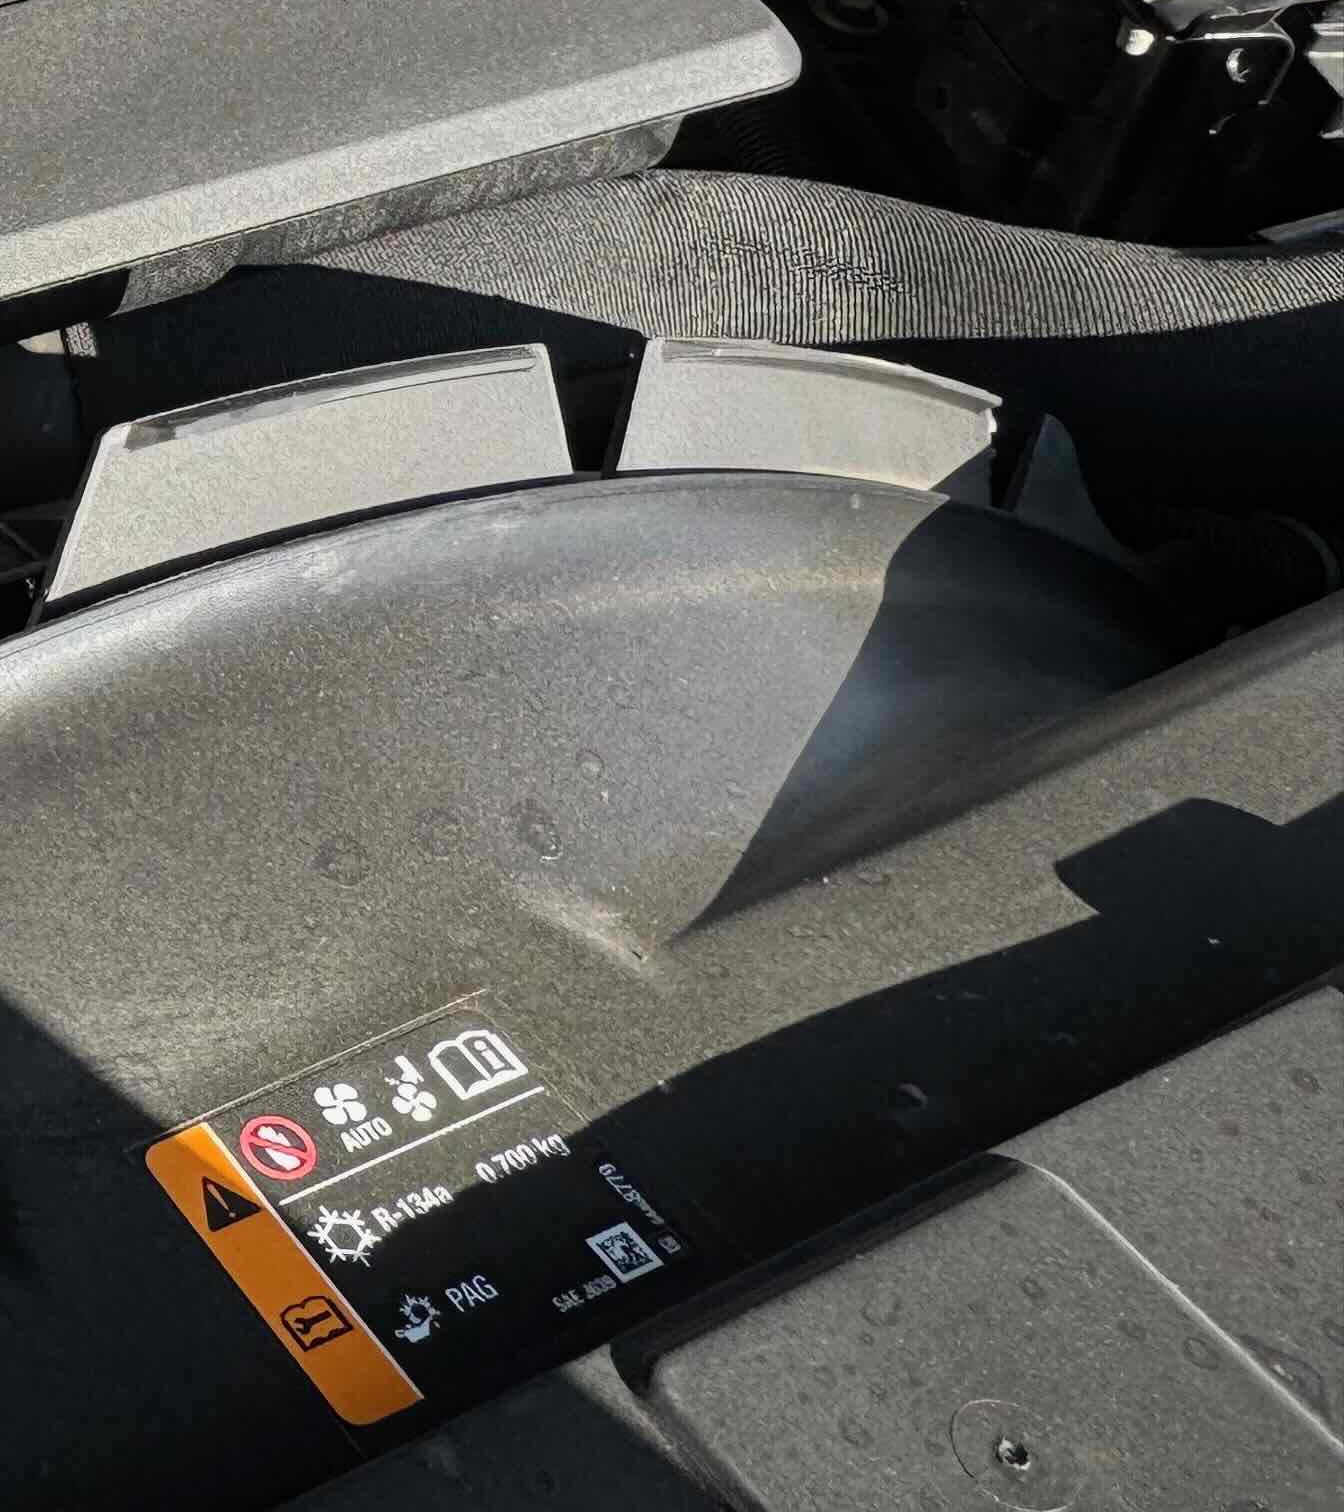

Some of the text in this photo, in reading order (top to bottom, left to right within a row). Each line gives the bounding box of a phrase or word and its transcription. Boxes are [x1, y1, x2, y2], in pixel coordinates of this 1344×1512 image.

[340, 1116, 393, 1153] AUTO
[370, 1133, 571, 1233] R-134a 0.700 kg
[444, 1275, 499, 1313] PAG
[552, 1289, 585, 1312] SAE
